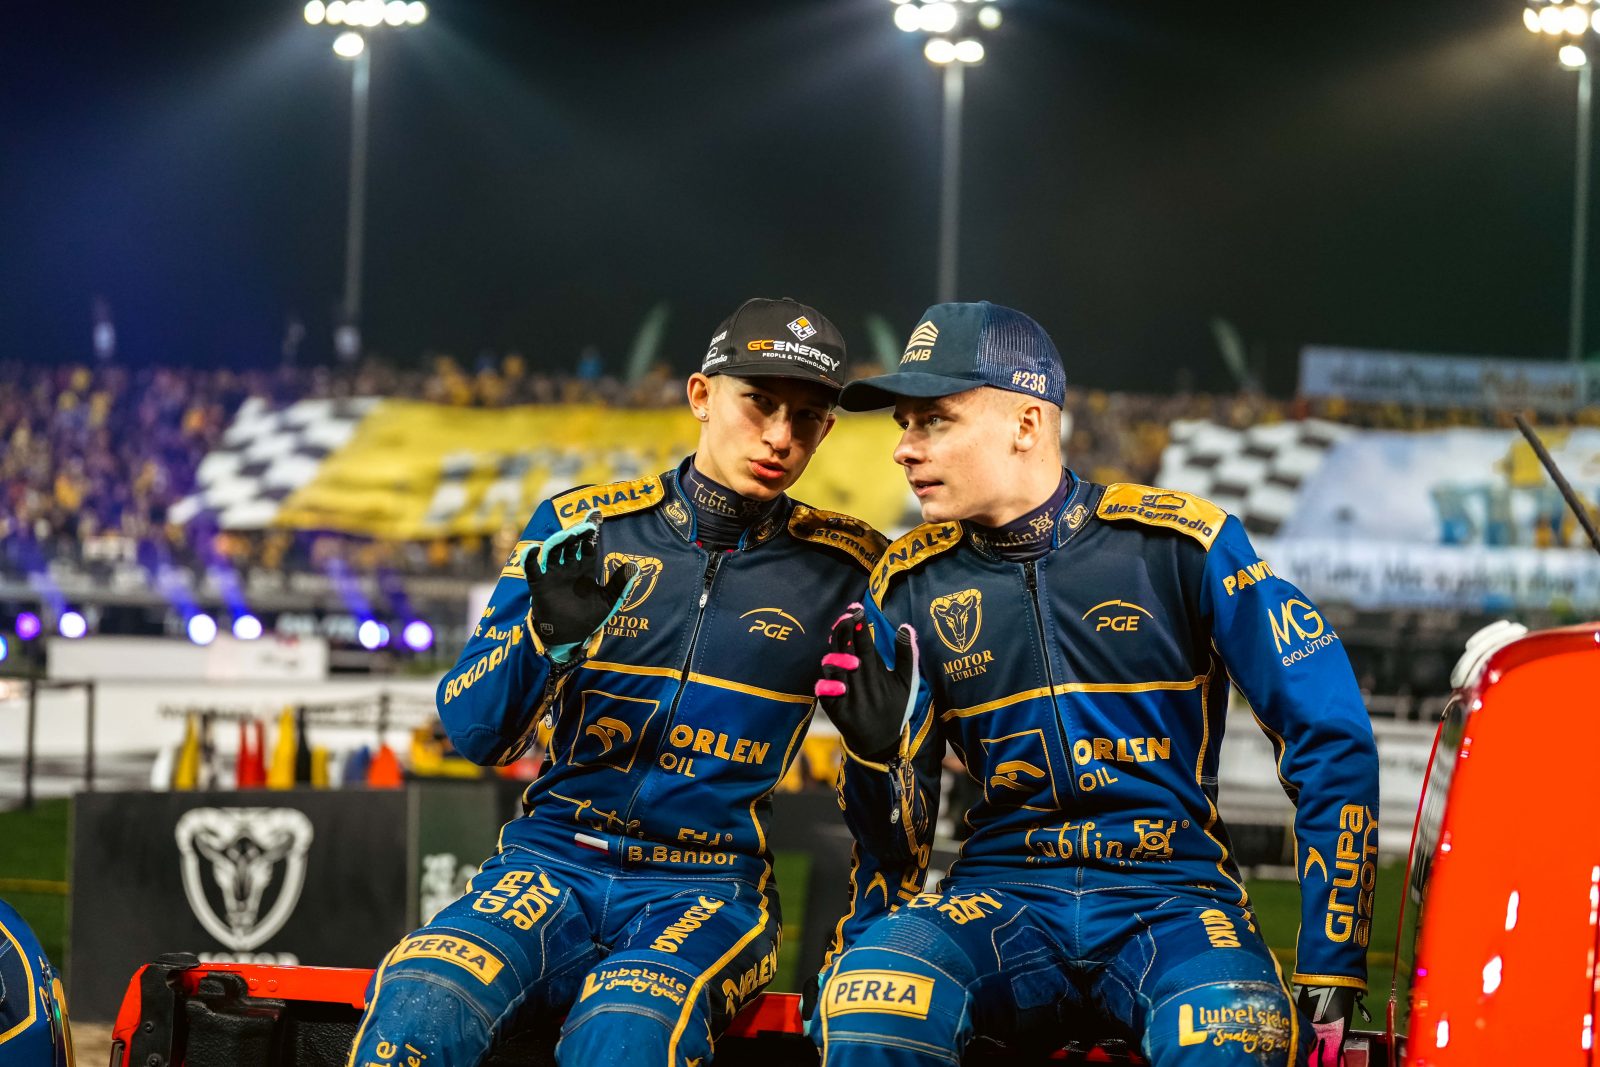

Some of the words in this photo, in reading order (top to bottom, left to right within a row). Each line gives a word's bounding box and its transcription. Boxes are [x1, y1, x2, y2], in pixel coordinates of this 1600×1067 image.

[794, 355, 828, 372] TECHNOLOGY
[1012, 370, 1047, 394] #238
[559, 483, 655, 519] CANAL+
[1104, 503, 1213, 538] Mastermedia
[871, 525, 956, 596] CANAL+
[606, 614, 649, 630] OTOR
[749, 619, 793, 641] PGE
[1095, 615, 1140, 632] PGE
[1267, 598, 1324, 654] MG
[942, 650, 995, 675] MOTOR
[951, 664, 987, 682] LUBLIN
[669, 724, 771, 765] ORLEN
[1073, 737, 1171, 766] ORLEN
[659, 752, 696, 778] OIL
[1078, 766, 1118, 792] OIL
[403, 938, 488, 971] PERŁA
[834, 979, 917, 1006] PERŁA
